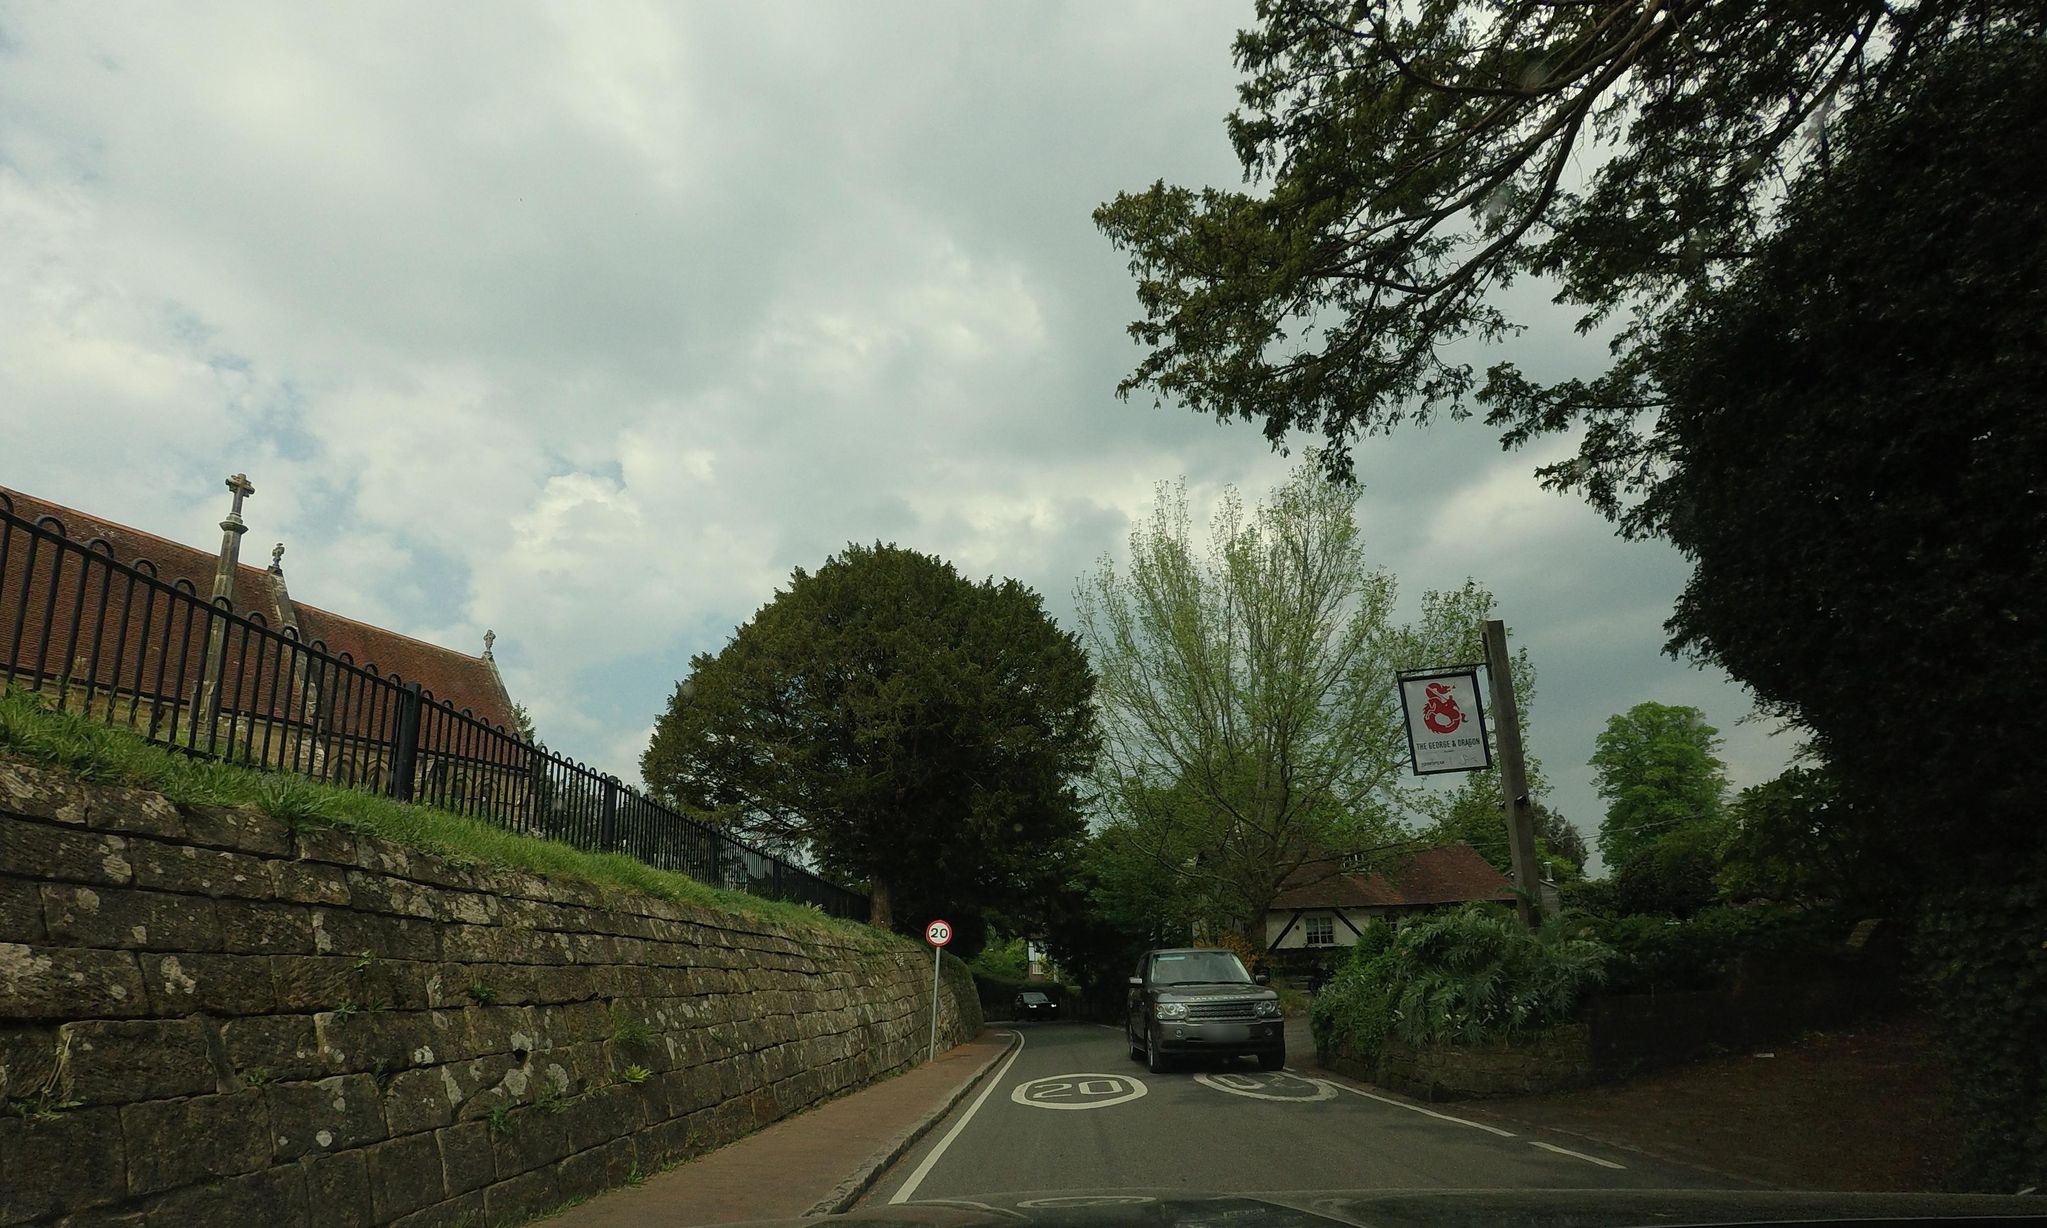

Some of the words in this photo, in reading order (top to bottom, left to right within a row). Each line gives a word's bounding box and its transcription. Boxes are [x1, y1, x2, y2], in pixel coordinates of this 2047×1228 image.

[1416, 743, 1427, 751] THE
[1428, 740, 1451, 750] GEORGE
[1457, 738, 1481, 748] DRAGON
[930, 928, 948, 938] 20
[1033, 1080, 1123, 1098] 20
